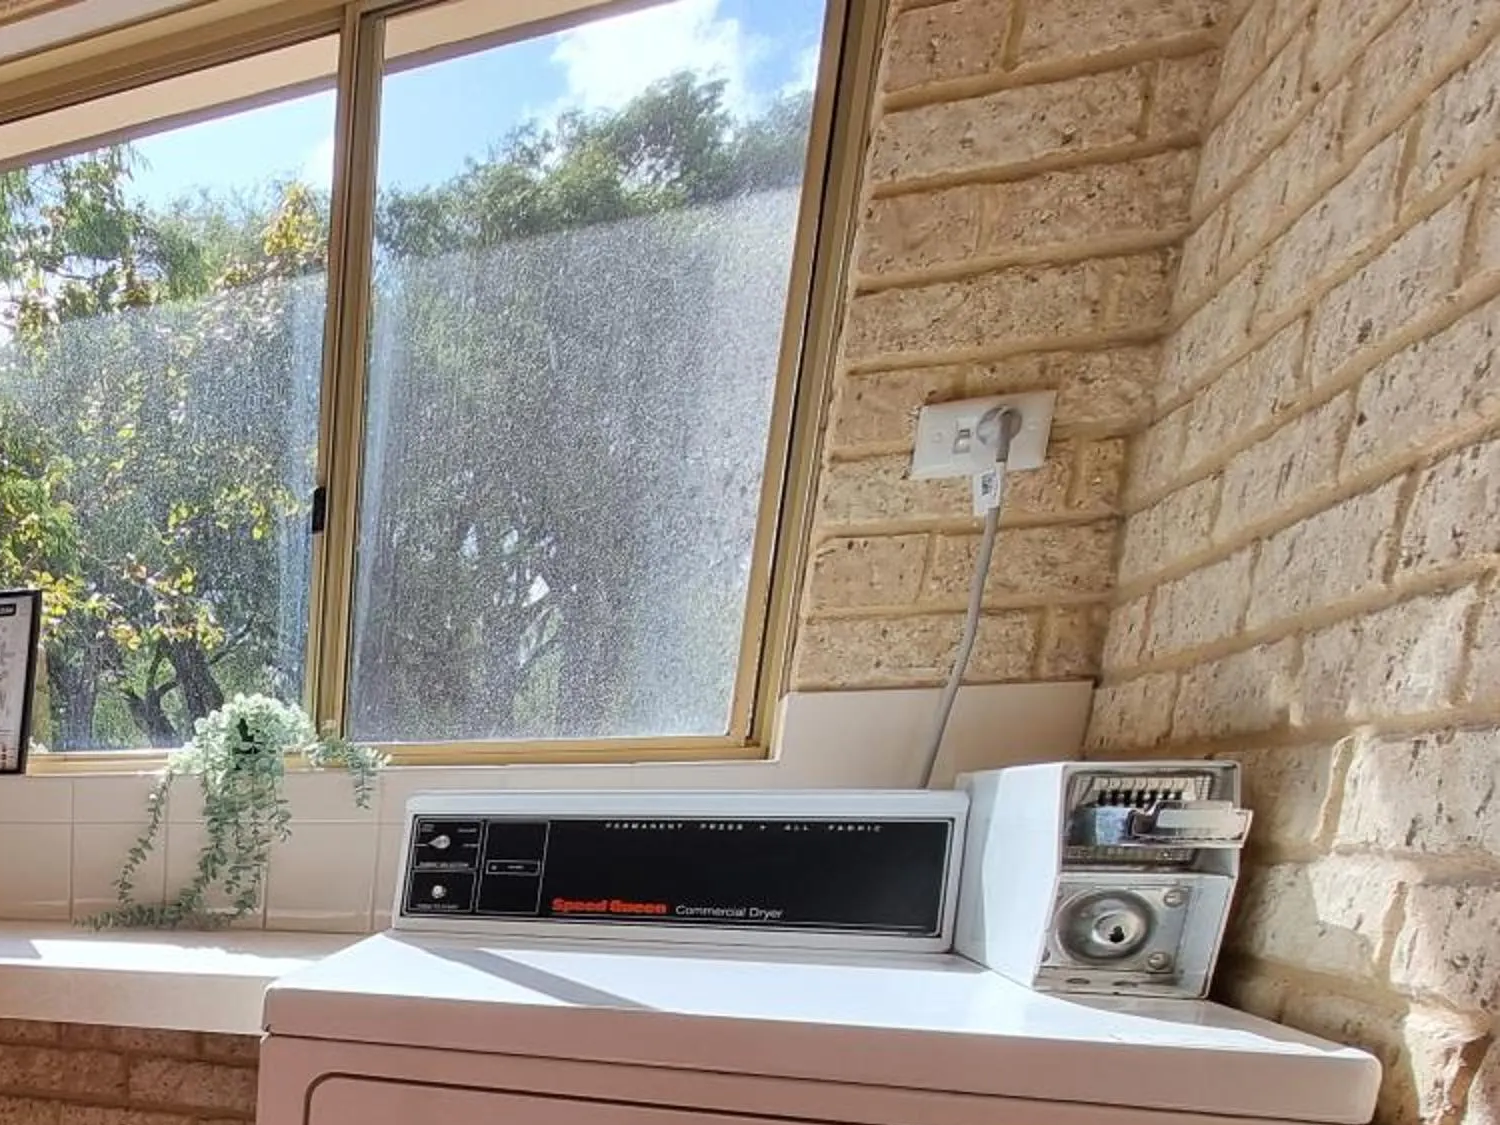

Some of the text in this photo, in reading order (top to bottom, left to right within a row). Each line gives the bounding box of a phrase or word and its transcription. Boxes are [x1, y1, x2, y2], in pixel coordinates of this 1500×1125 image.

[551, 897, 607, 915] Speed
[675, 904, 746, 917] Commercial
[749, 906, 784, 922] Dryer
